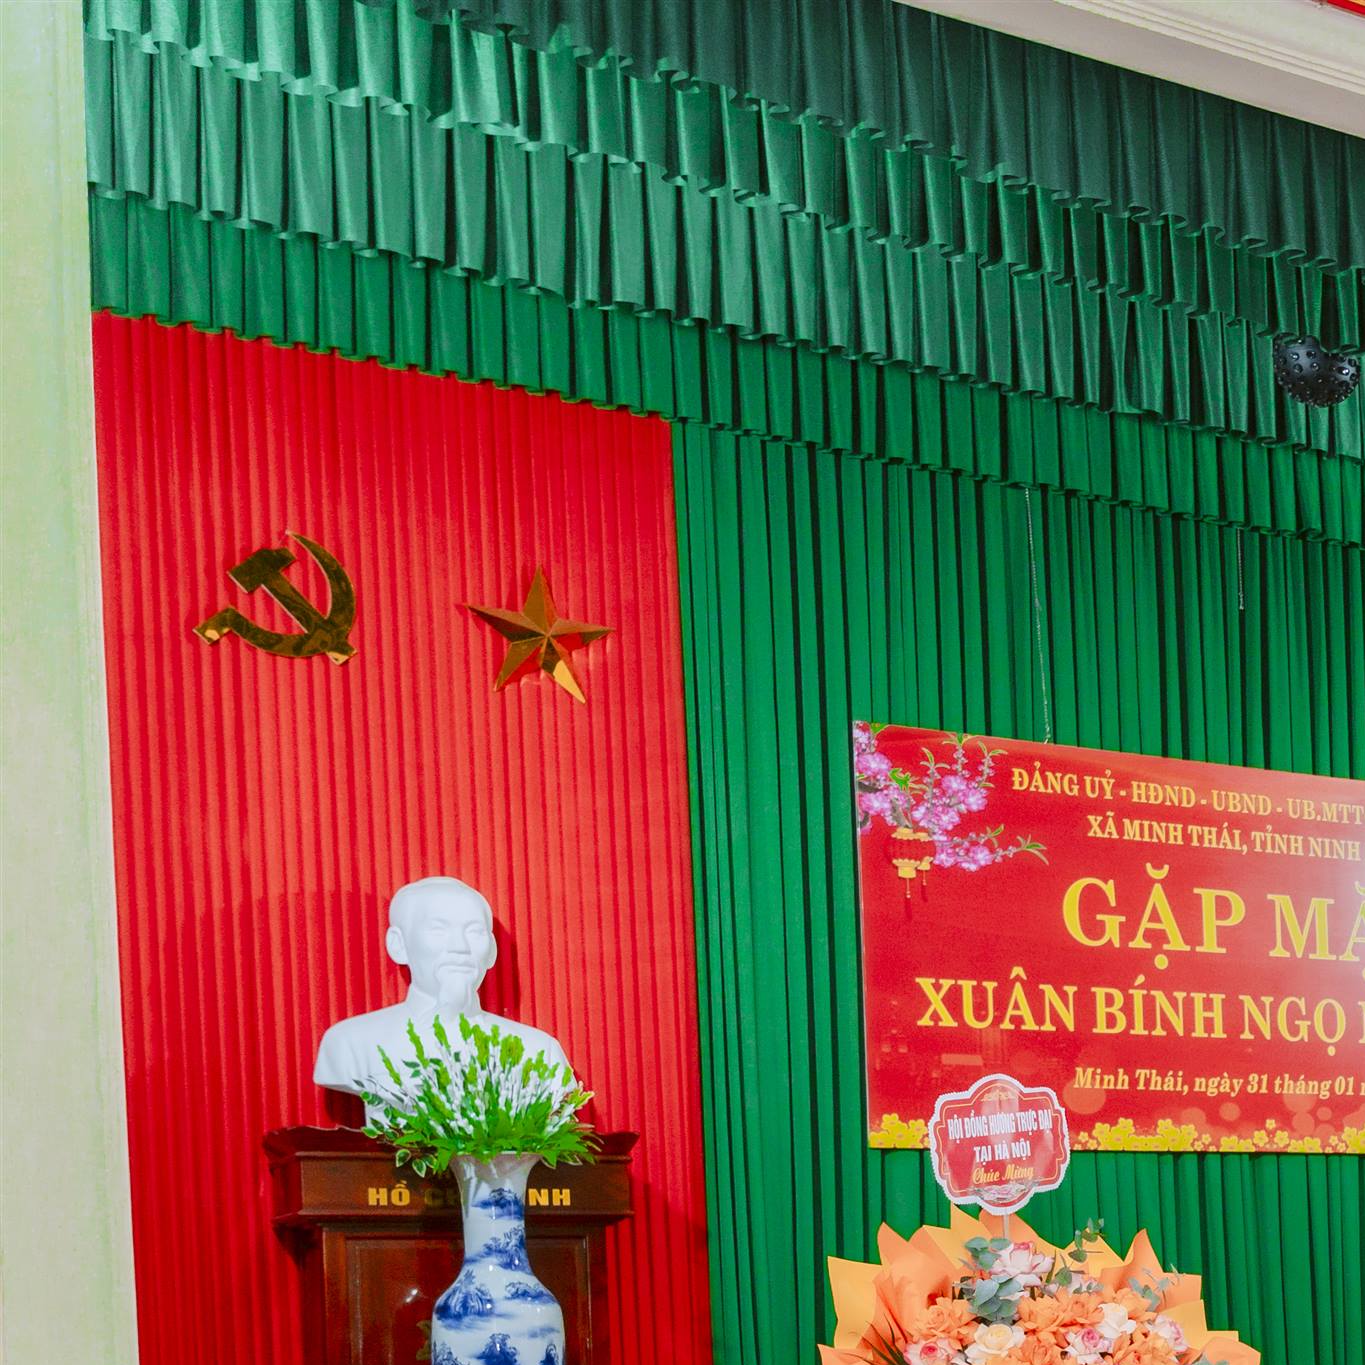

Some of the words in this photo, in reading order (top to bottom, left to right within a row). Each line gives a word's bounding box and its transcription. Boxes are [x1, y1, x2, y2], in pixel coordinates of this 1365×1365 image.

[1012, 761, 1079, 796] ĐẢNG
[1083, 768, 1116, 800] UỶ
[1131, 780, 1196, 808] HĐND
[1211, 789, 1272, 816] UBND
[1087, 811, 1119, 839] XÃ
[1123, 818, 1183, 845] MINH
[1188, 822, 1248, 855] THÁI,
[1251, 824, 1304, 856] TỈNH
[1308, 836, 1361, 862] NINH
[1062, 862, 1246, 970] GẶP
[914, 966, 1078, 1032] XUÂN
[1091, 974, 1228, 1039] BÍNH
[1238, 994, 1347, 1057] NGỌ
[1072, 1067, 1130, 1090] Minh
[1134, 1069, 1190, 1095] Thái,
[1193, 1072, 1245, 1097] ngày
[1246, 1074, 1269, 1095] 31
[1274, 1074, 1332, 1100] tháng
[1334, 1076, 1356, 1097] 01
[947, 1114, 964, 1143] HỘI
[964, 1110, 989, 1138] ĐỒNG
[973, 1145, 992, 1165] TẠI
[995, 1140, 1010, 1161] HÀ
[1012, 1138, 1031, 1160] NỘI
[972, 1168, 1000, 1185] Chúc
[368, 1180, 410, 1207] HỒ
